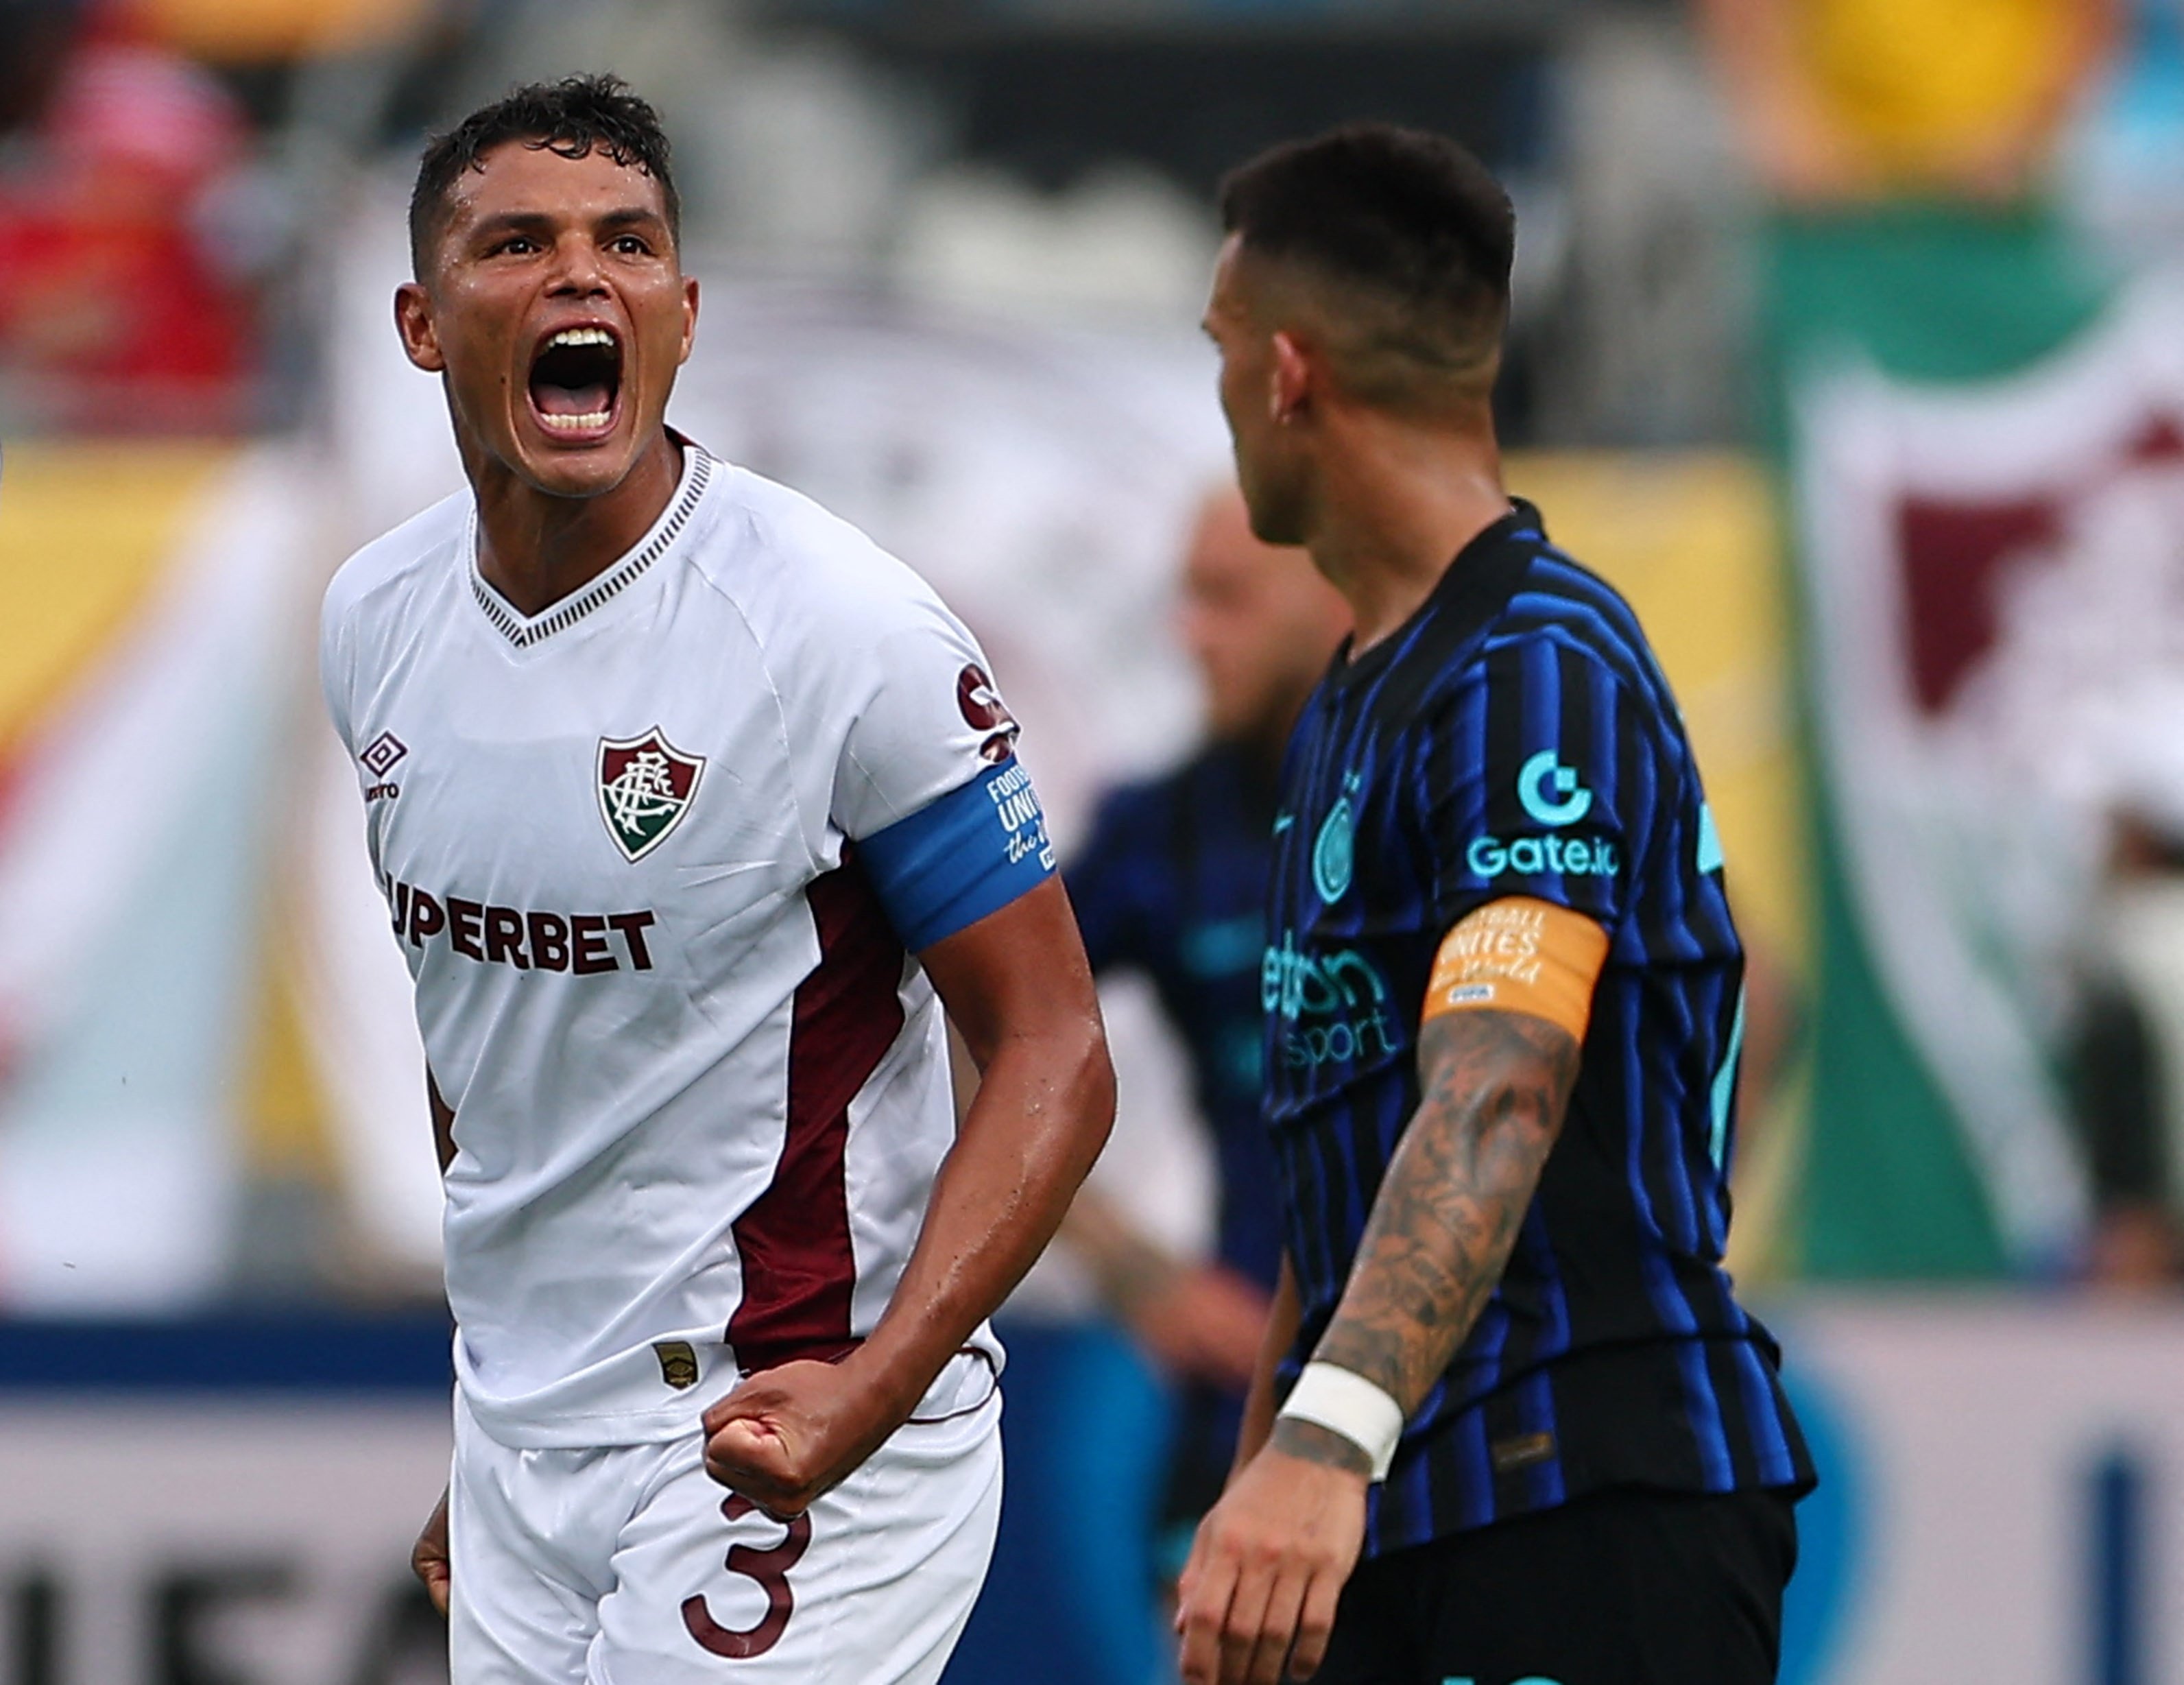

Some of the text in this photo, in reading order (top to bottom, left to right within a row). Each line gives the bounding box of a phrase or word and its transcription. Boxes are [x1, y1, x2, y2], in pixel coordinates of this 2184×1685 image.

[987, 765, 1029, 803] FOOT
[998, 787, 1039, 832] UNI
[387, 870, 656, 975] UPERBET
[682, 1491, 812, 1660] 3
